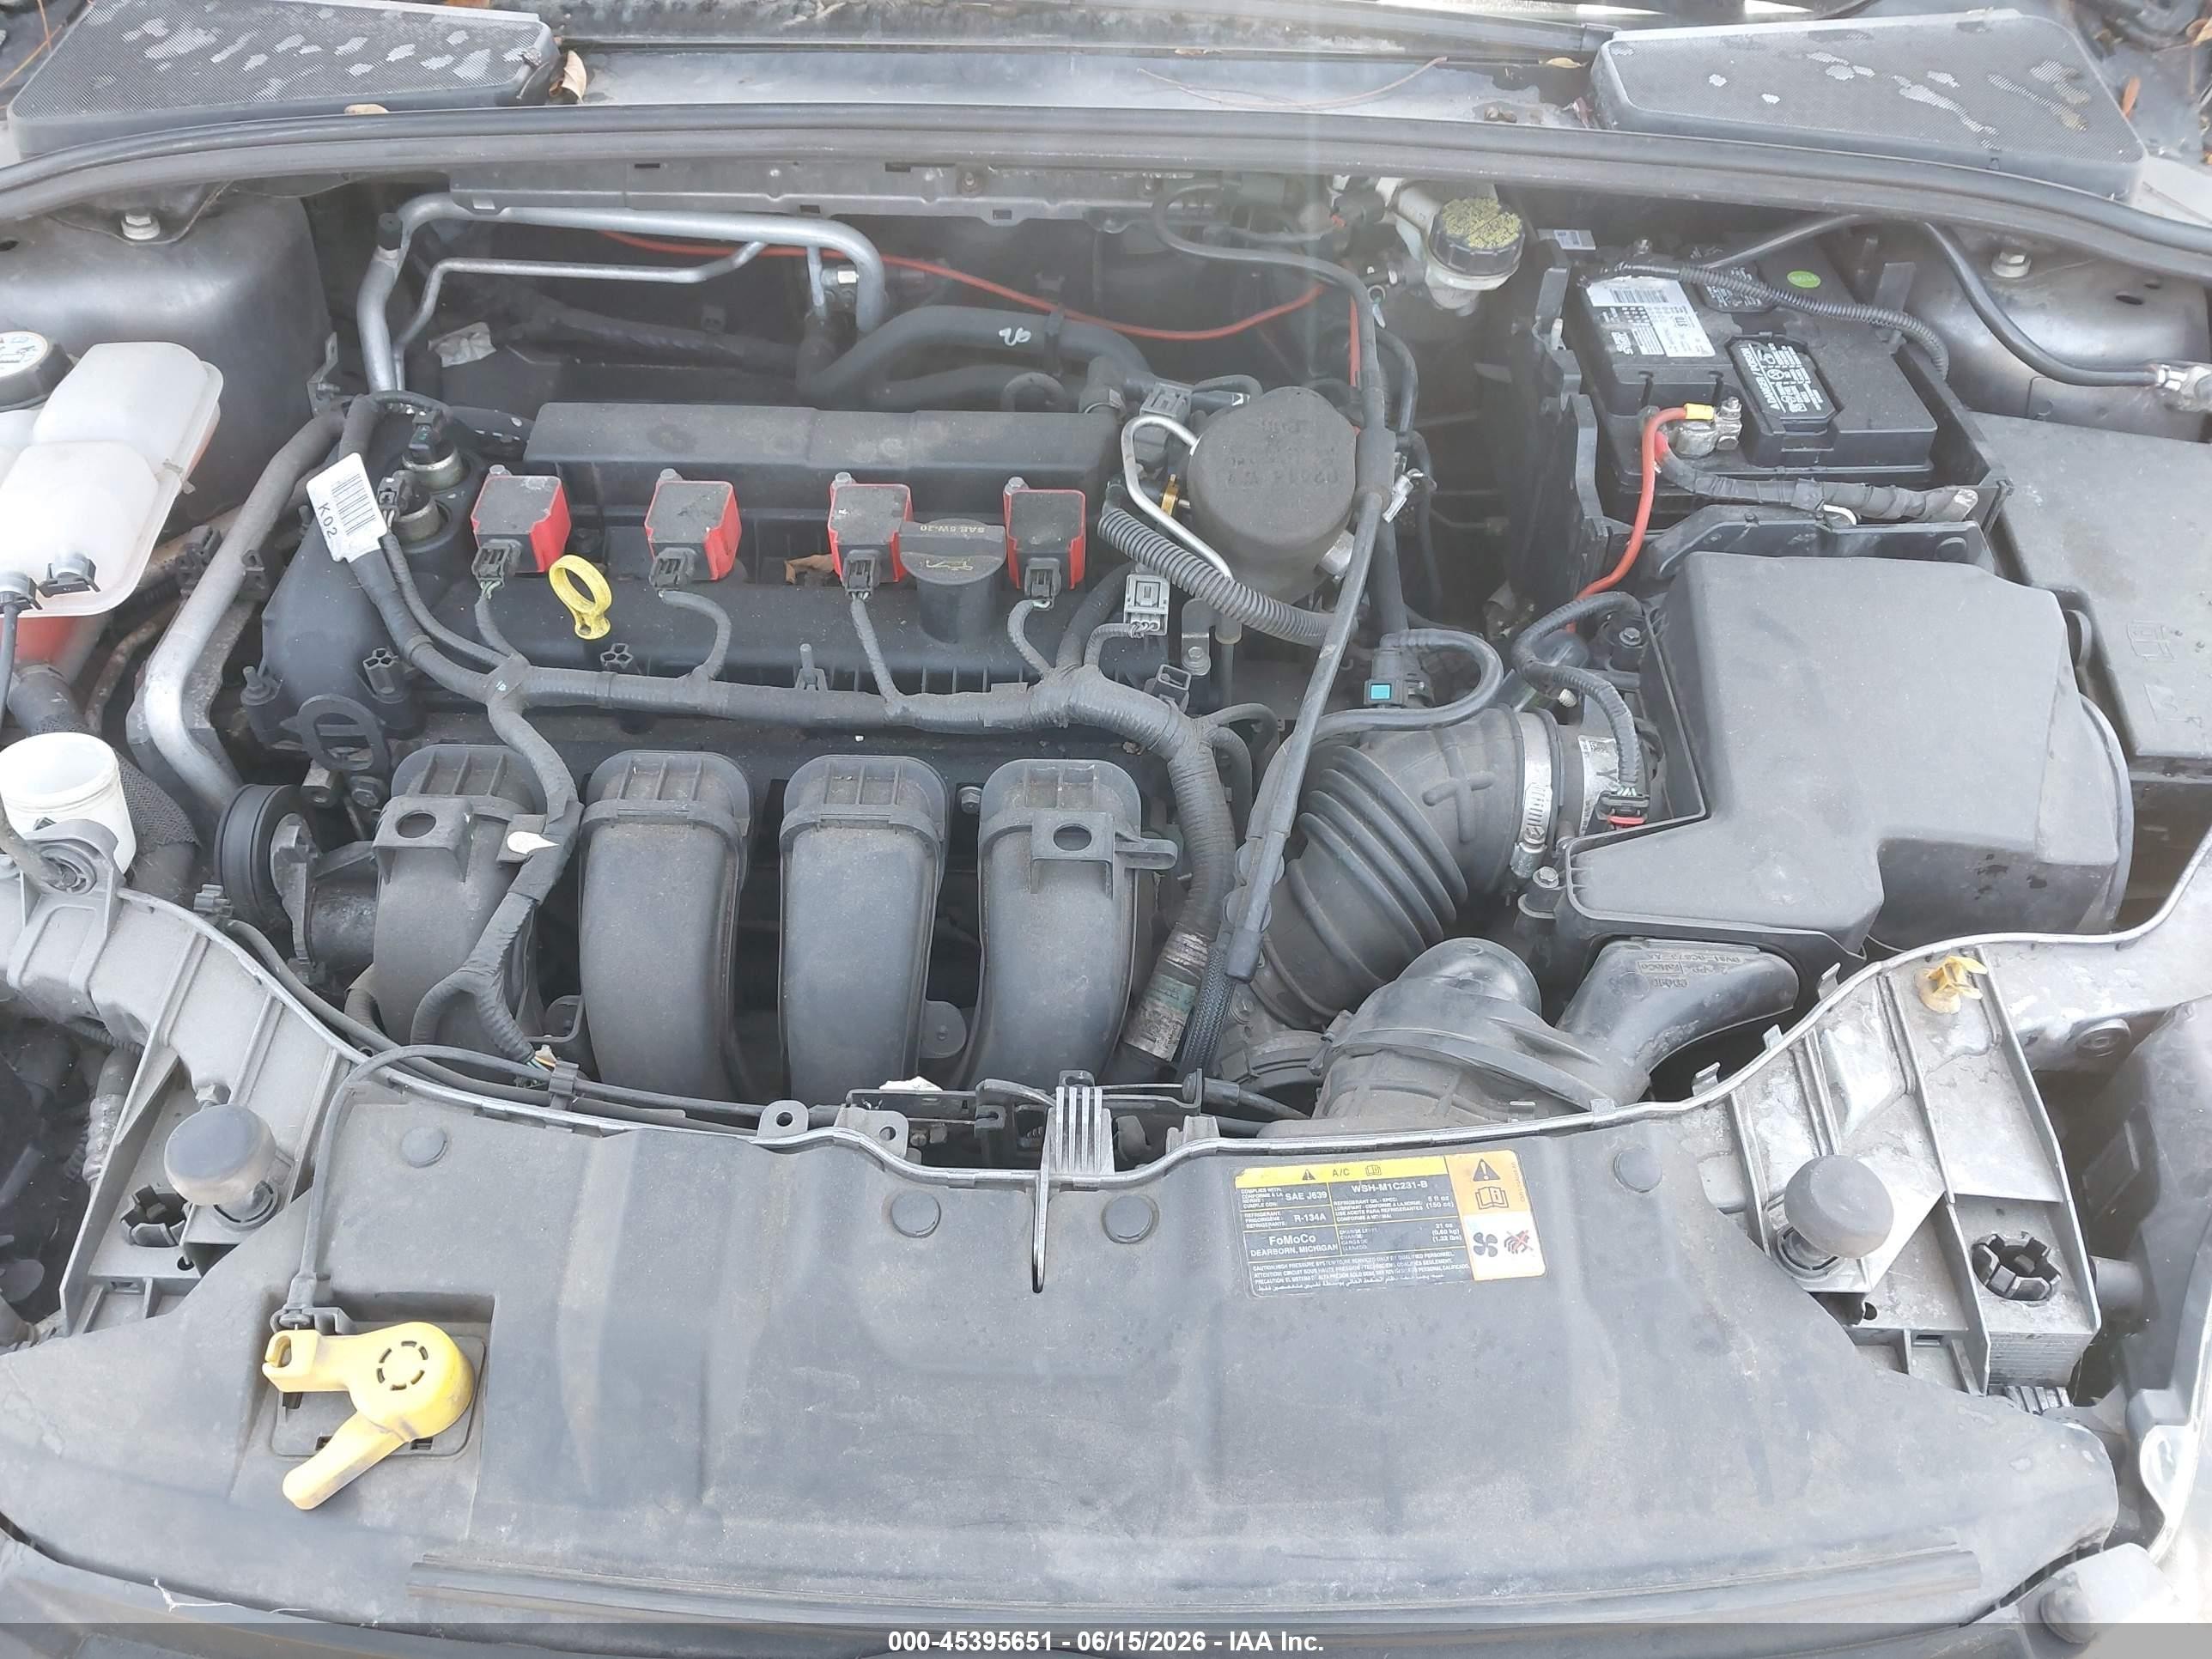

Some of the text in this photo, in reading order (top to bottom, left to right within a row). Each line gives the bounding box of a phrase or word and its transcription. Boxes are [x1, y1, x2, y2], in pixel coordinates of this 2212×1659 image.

[318, 502, 337, 538] K02
[1332, 1168, 1351, 1177] A/C
[1351, 1181, 1428, 1193] WSH-M1C231-B
[1285, 1190, 1328, 1200] SAE J639
[1425, 1200, 1442, 1209] (150
[1293, 1212, 1326, 1223] R-134A
[1268, 1233, 1316, 1245] FoMoCo
[1298, 1244, 1338, 1253] MICHIGAN
